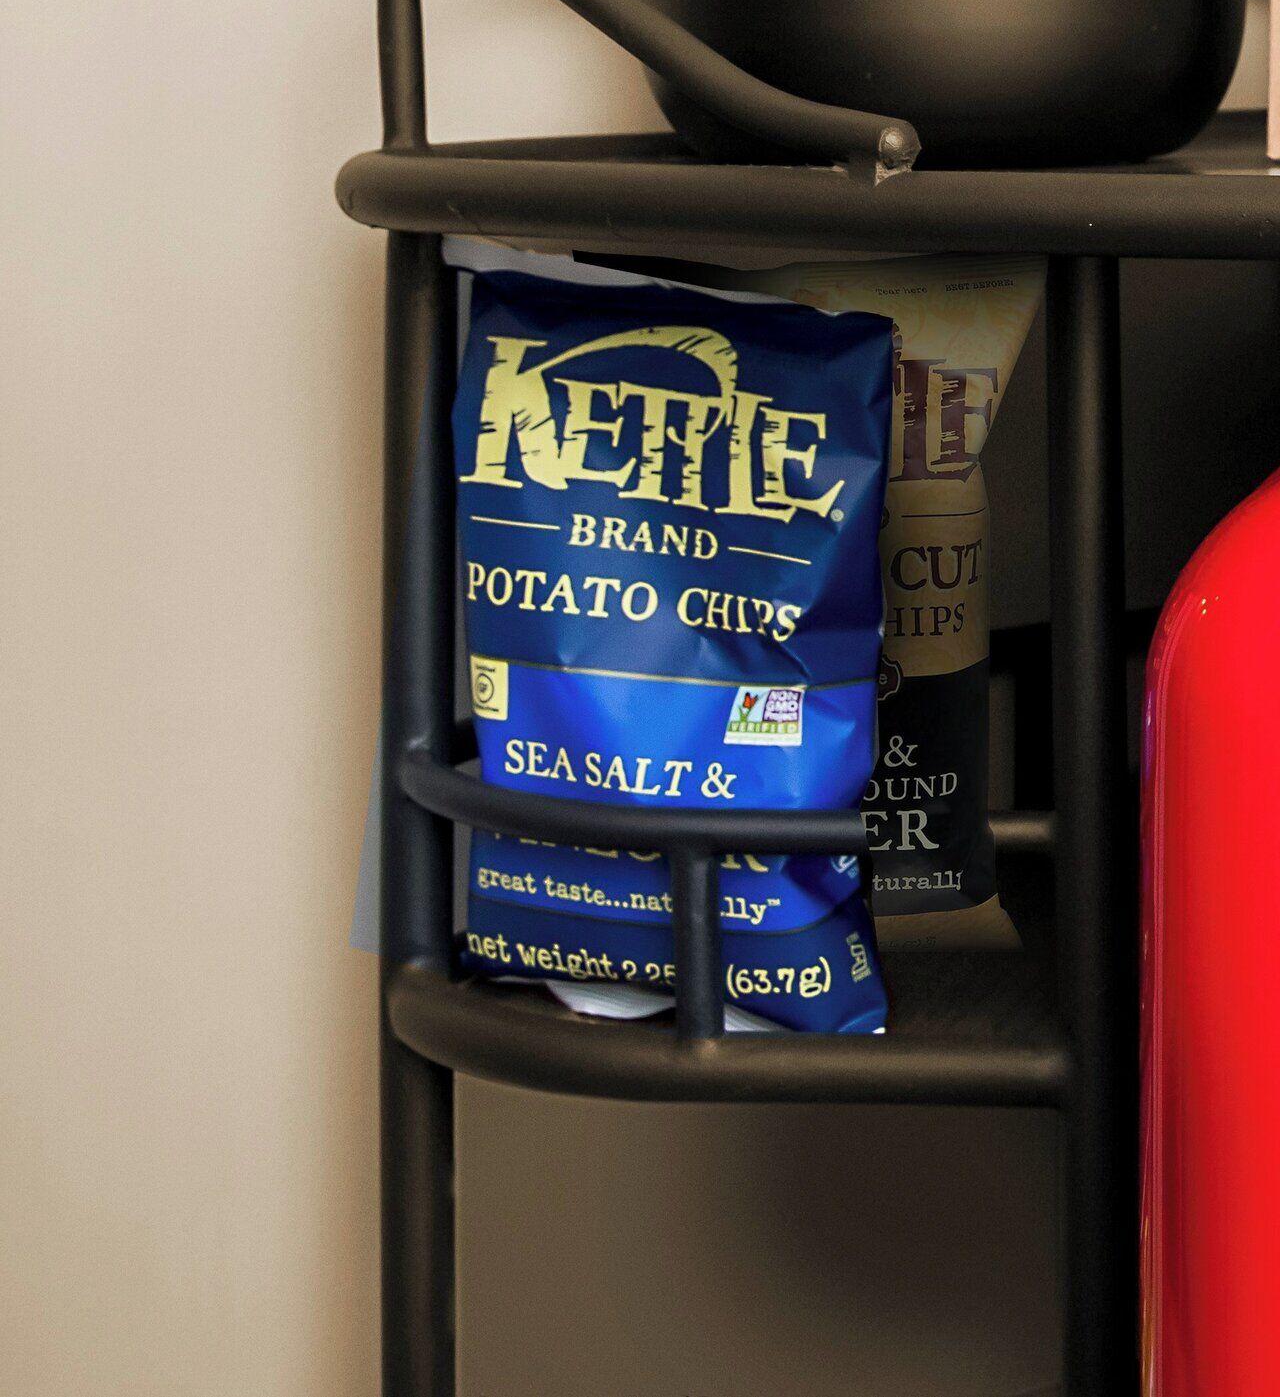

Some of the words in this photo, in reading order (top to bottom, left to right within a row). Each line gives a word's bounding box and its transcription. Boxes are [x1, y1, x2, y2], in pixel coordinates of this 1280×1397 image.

[902, 286, 928, 295] here
[459, 326, 844, 523] KETTLE
[568, 513, 719, 560] BRAND
[891, 539, 982, 591] CUT
[467, 562, 658, 621] POTATO
[677, 587, 802, 642] CHIPS
[884, 602, 966, 637] HIPS
[766, 700, 798, 712] GMO
[769, 690, 798, 701] NON
[731, 721, 797, 733] VERIFIED
[884, 735, 918, 768] &
[505, 739, 577, 783] SEA
[584, 752, 693, 796] SALT
[700, 763, 737, 799] &
[863, 772, 958, 802] OUND
[477, 866, 537, 894] great
[467, 931, 511, 964] net
[516, 941, 618, 980] weight
[726, 956, 832, 998] (63.7g)
